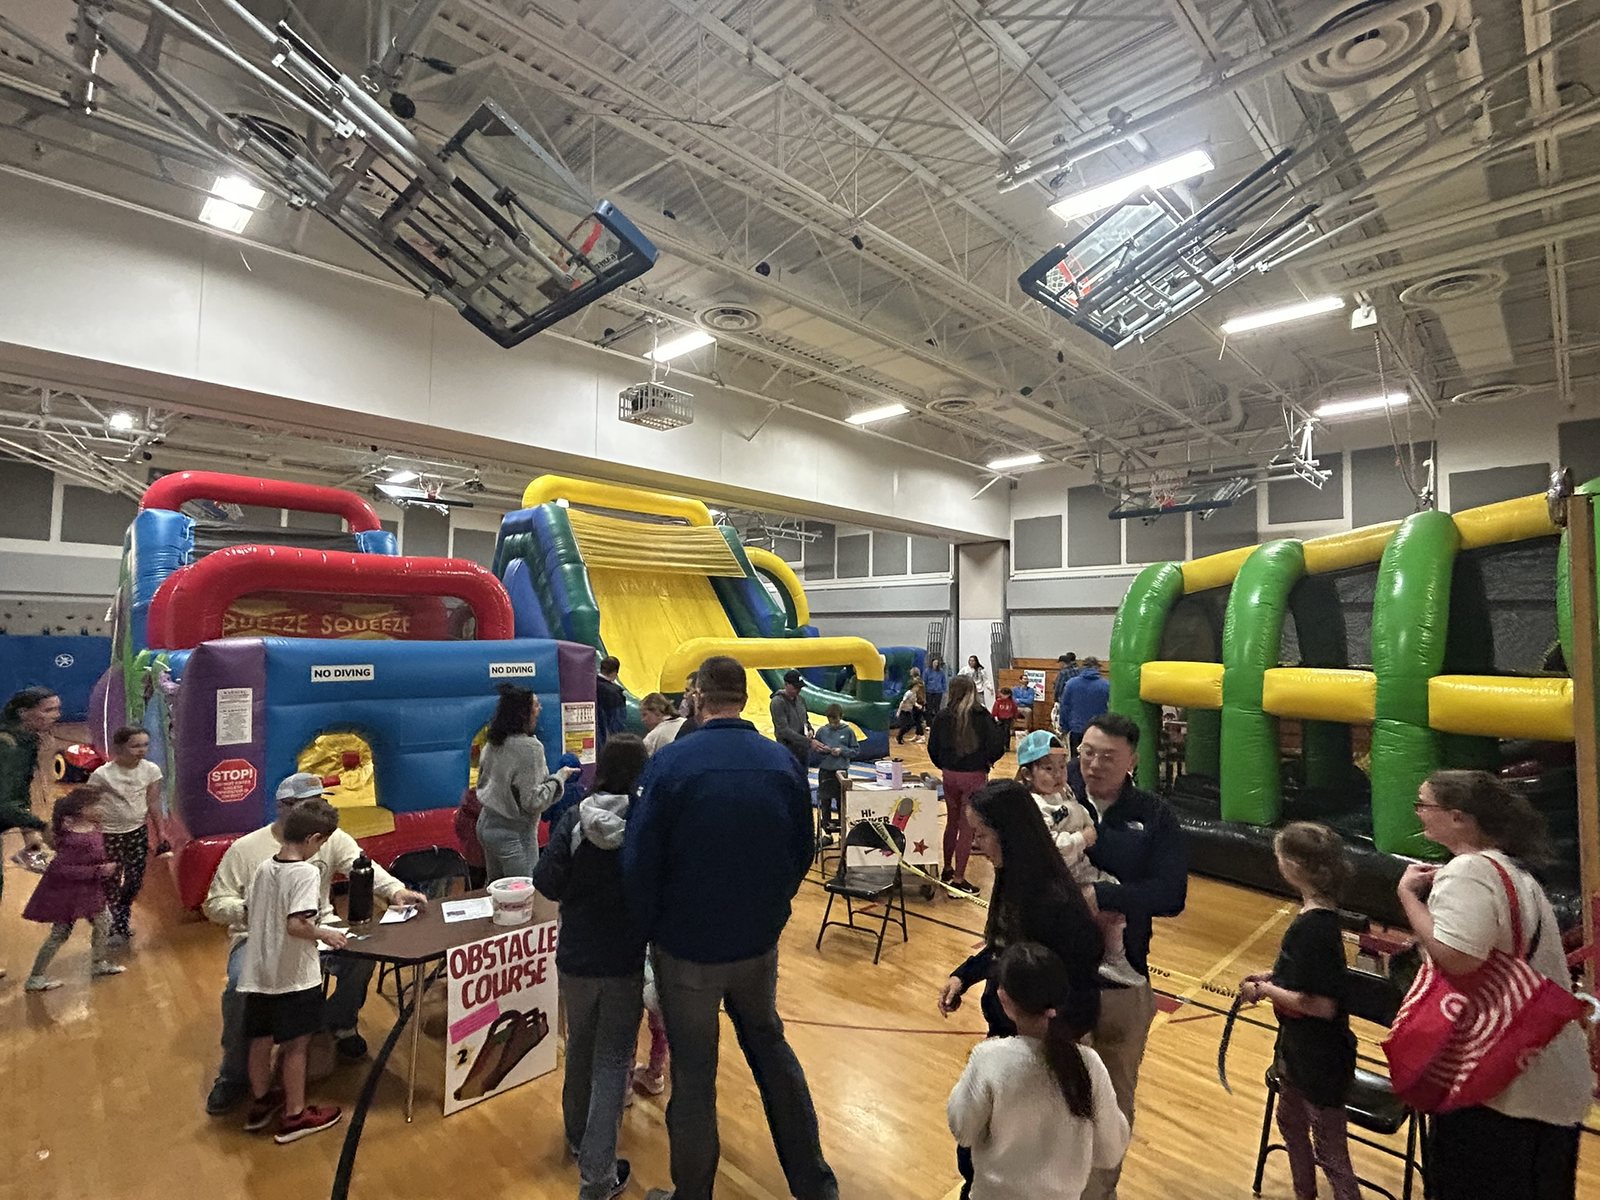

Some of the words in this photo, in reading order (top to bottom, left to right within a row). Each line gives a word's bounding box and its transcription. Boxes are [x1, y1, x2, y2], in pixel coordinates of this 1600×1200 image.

[321, 615, 411, 634] SQUEEZE
[314, 669, 331, 678] NO
[334, 668, 371, 678] DIVING
[506, 666, 534, 674] DIVING
[211, 768, 253, 782] STOP!
[449, 926, 557, 979] OBSTACLE
[461, 957, 547, 1010] COURSE
[456, 1048, 469, 1066] 2
